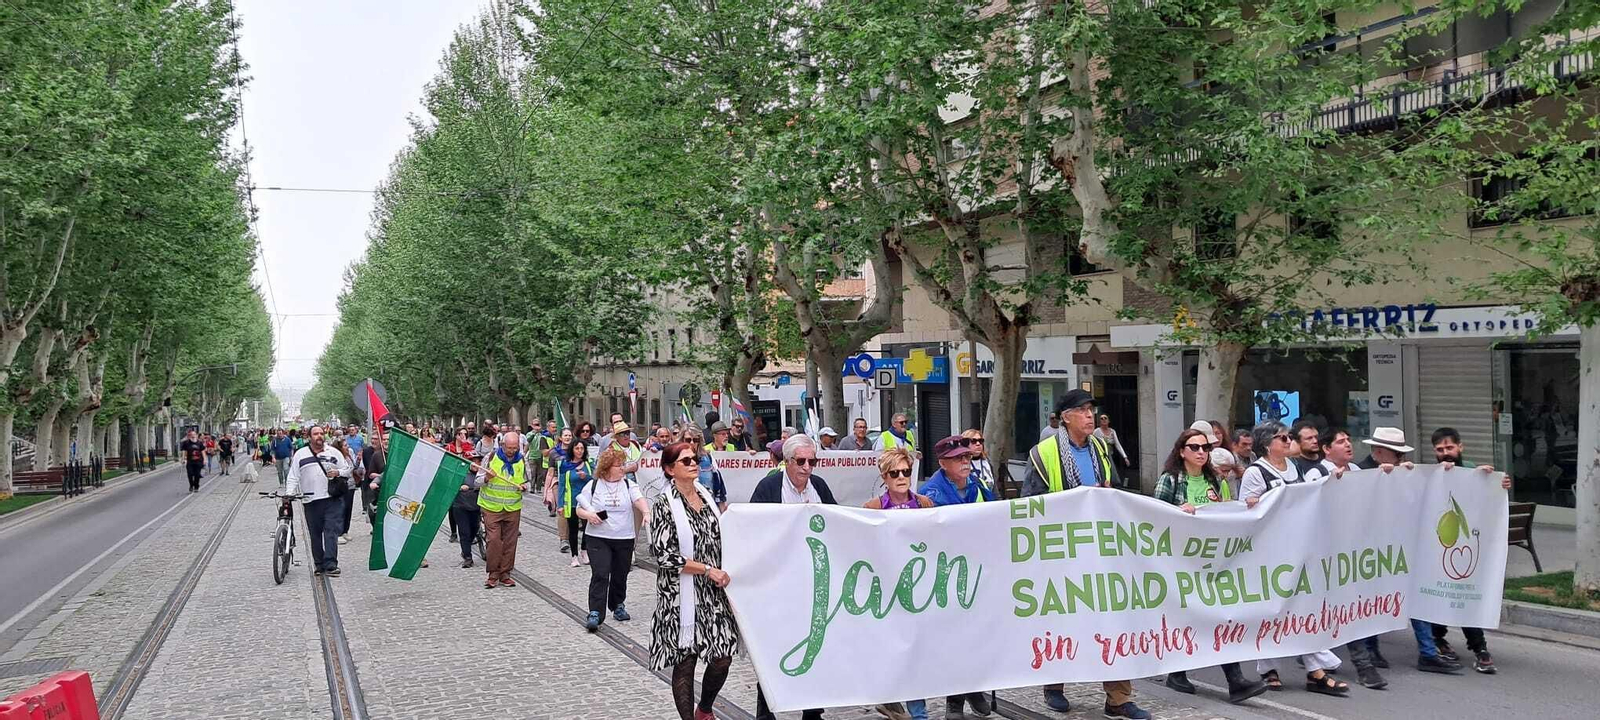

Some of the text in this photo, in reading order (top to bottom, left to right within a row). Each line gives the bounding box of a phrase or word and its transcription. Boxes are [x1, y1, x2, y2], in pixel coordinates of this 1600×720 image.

[1449, 319, 1534, 332] ORTOPED
[879, 371, 892, 386] D
[715, 458, 740, 469] NARES
[741, 458, 753, 469] EN
[754, 458, 777, 469] DEFEN
[817, 458, 836, 468] TEMA
[867, 457, 877, 467] DE
[1010, 495, 1045, 520] EN
[1010, 521, 1253, 563] DEFENSA DE UNA
[1012, 545, 1409, 618] SANIDAD PÚBLICA Y DIGNA
[1031, 631, 1079, 670] sin
[1213, 619, 1249, 652] sin
[1256, 590, 1406, 652] privatizaciones
